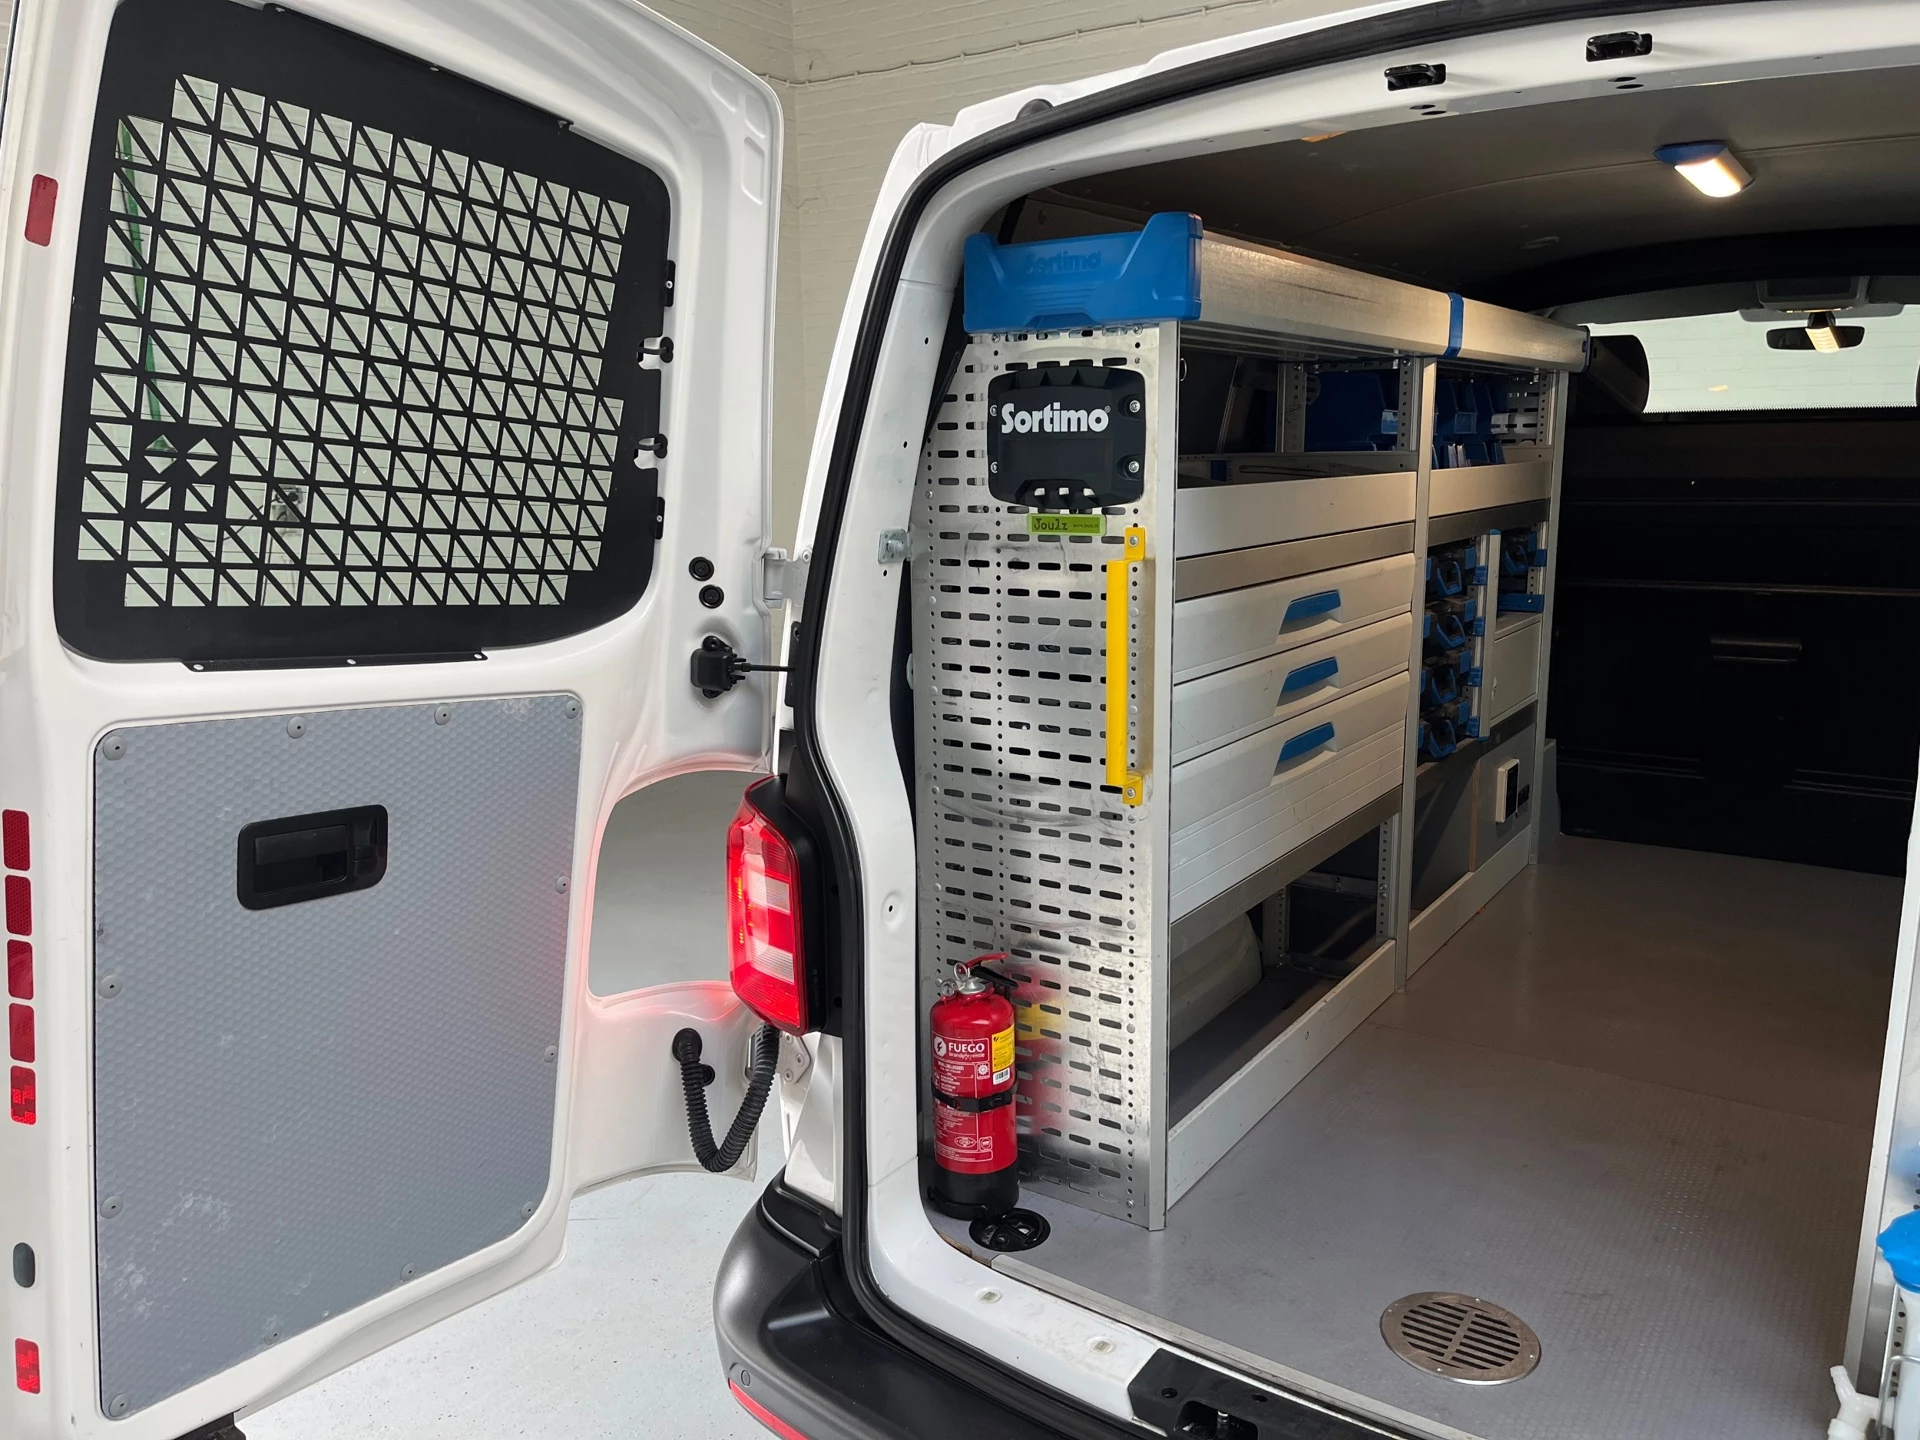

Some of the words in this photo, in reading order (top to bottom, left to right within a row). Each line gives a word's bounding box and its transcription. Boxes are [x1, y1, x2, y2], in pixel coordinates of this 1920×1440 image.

[1025, 249, 1102, 274] Sortimo
[1034, 517, 1068, 531] Joulz
[948, 1042, 985, 1053] FUEGO
